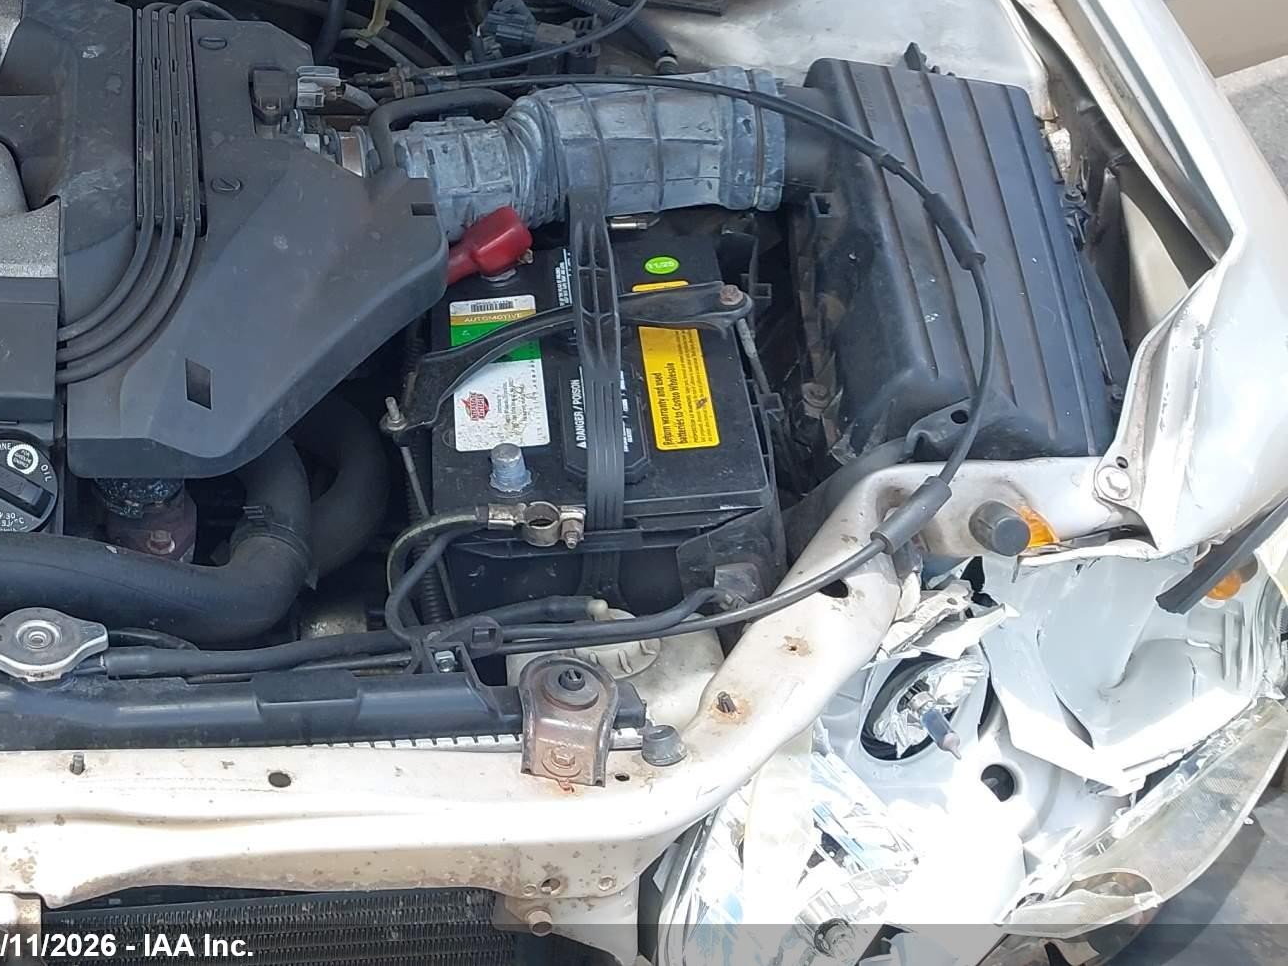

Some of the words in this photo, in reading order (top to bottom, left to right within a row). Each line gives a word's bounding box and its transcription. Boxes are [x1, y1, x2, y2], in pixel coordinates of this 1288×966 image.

[464, 313, 521, 323] AUTOMOTIVE
[651, 372, 664, 385] used
[664, 362, 678, 391] Wholesale
[570, 379, 583, 405] POISON
[654, 386, 665, 397] and
[672, 391, 683, 410] Costco
[657, 398, 670, 425] warranty
[574, 411, 587, 441] DANGER
[663, 425, 675, 446] Return
[674, 418, 689, 444] batteries
[40, 464, 52, 482] OIL
